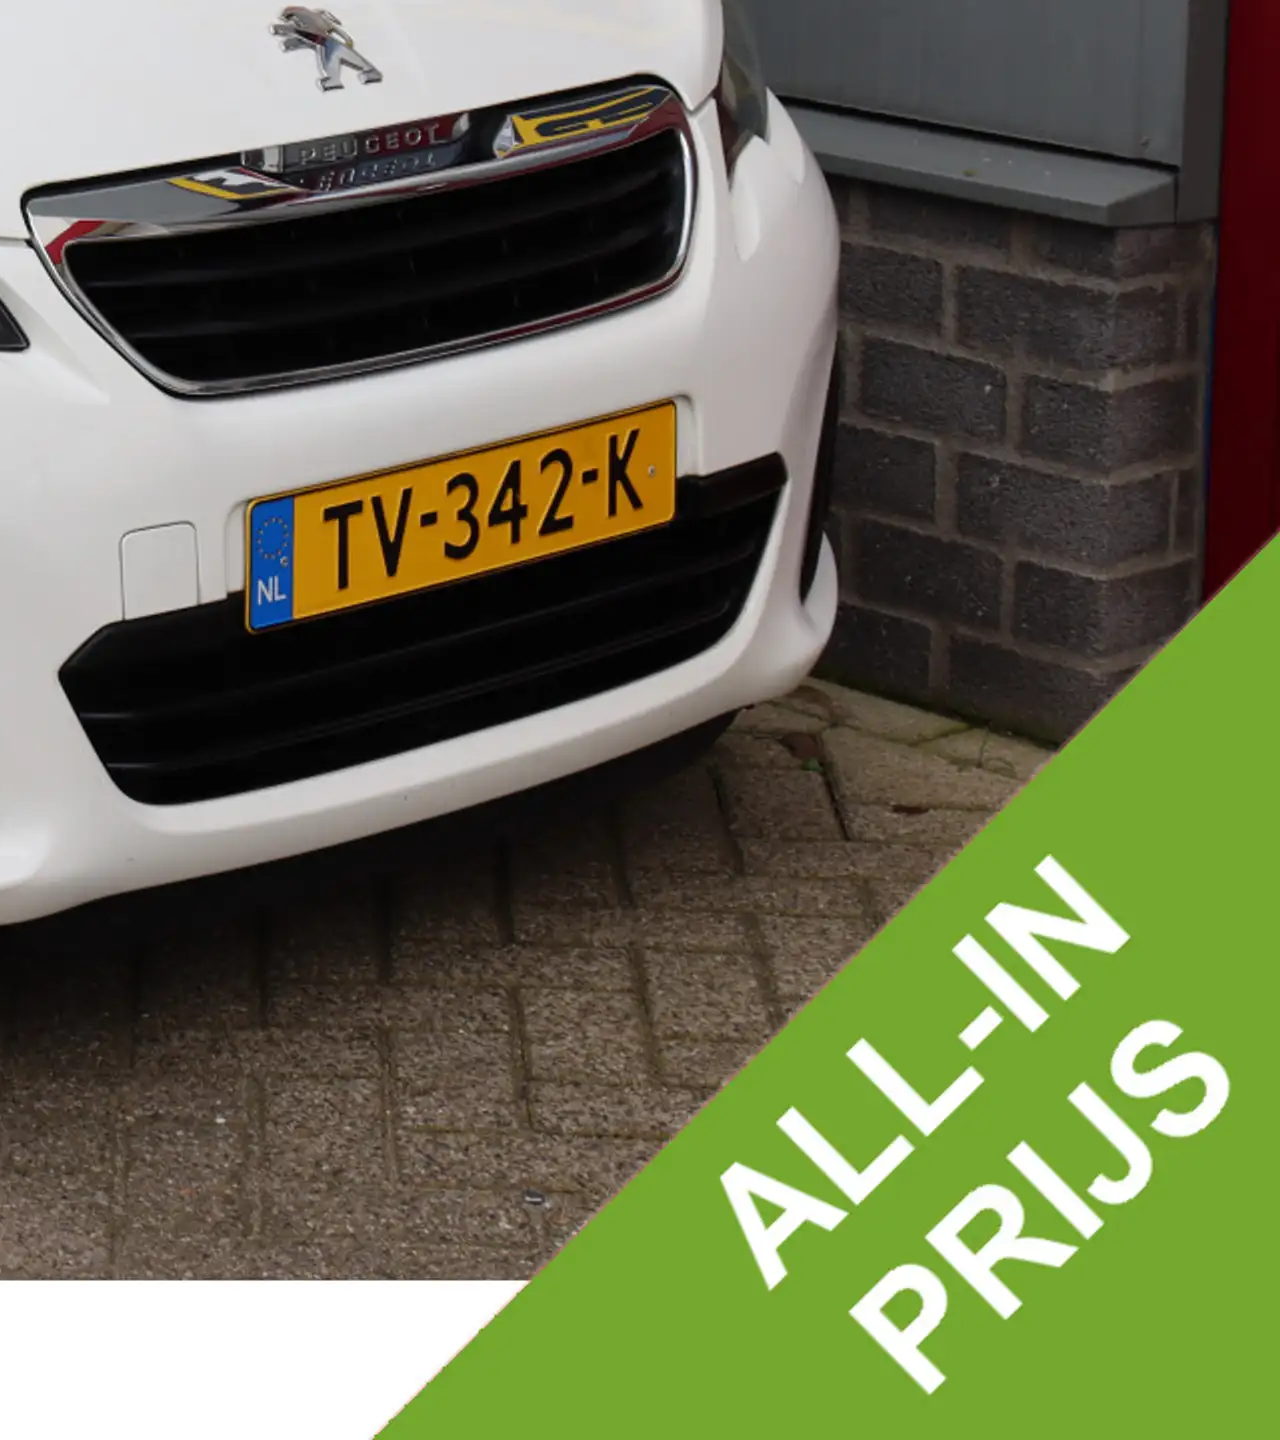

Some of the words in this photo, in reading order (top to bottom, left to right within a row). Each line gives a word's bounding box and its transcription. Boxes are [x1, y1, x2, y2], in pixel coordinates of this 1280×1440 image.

[300, 123, 444, 165] PEUGEOT
[322, 428, 644, 591] TV-342-K
[257, 576, 286, 606] NL
